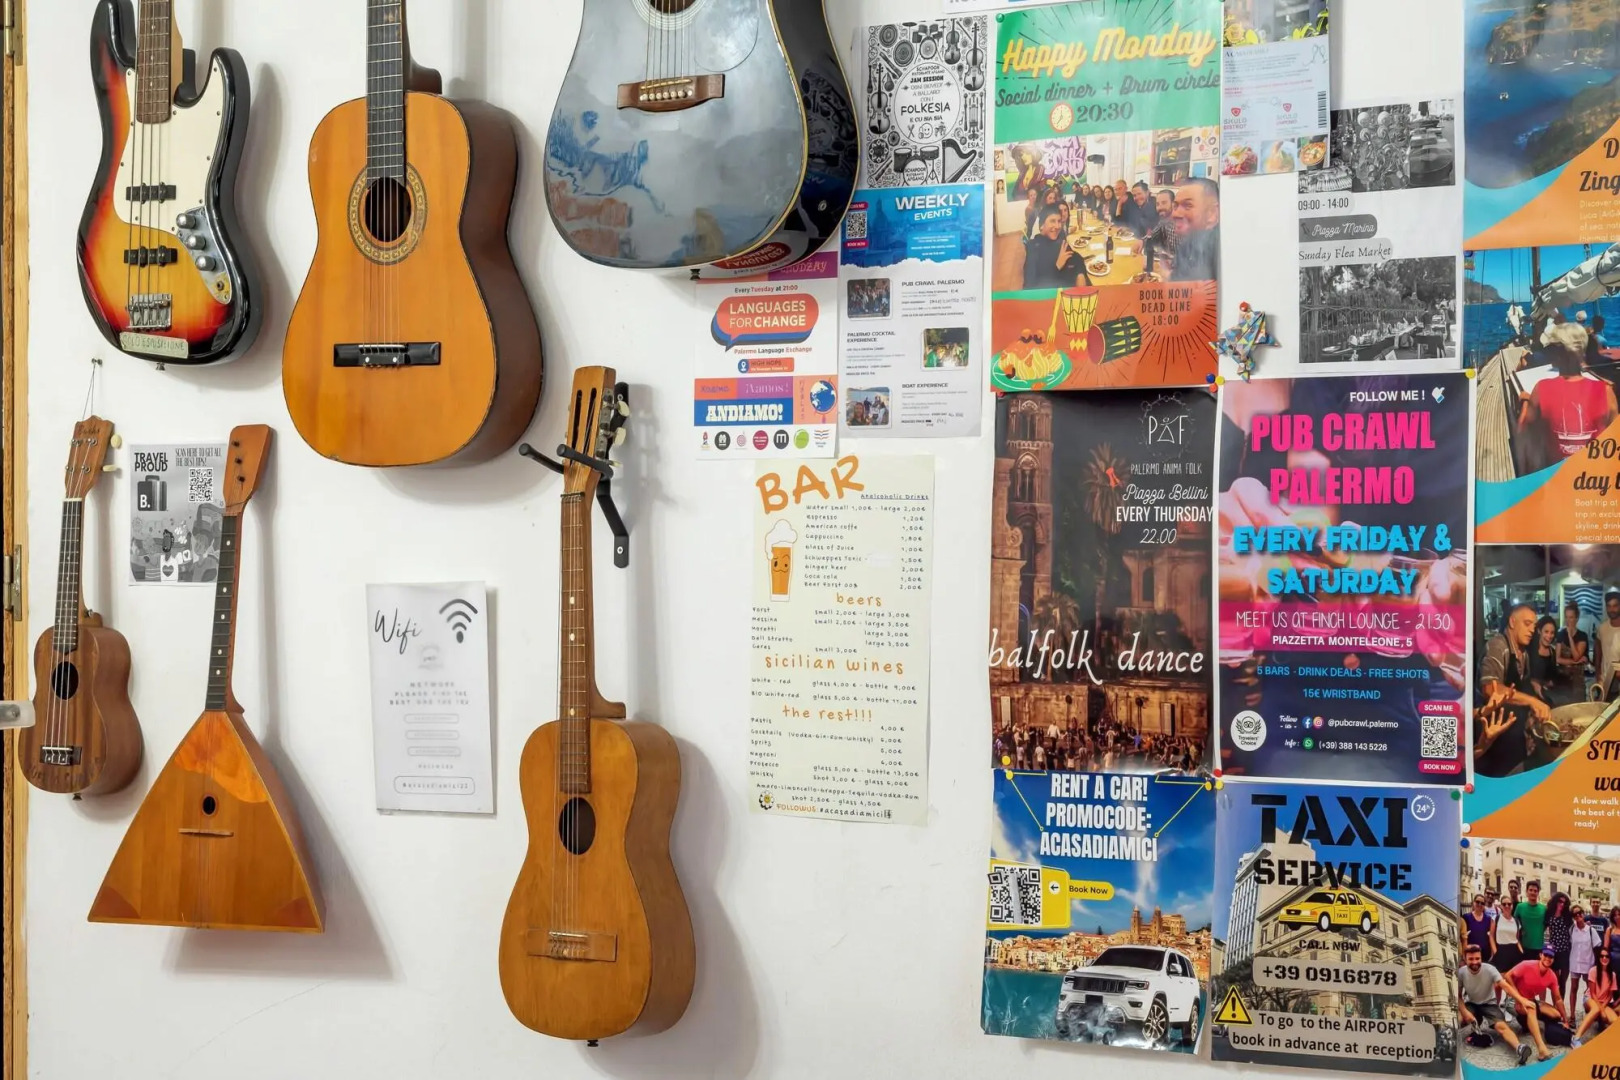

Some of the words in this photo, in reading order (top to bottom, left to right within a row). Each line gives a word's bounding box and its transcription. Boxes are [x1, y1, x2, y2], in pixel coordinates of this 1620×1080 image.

[1002, 38, 1087, 79] Happy
[1092, 23, 1219, 67] Monday
[995, 86, 1042, 108] Social
[1044, 83, 1096, 102] dinner
[1119, 73, 1168, 96] Drum
[1173, 68, 1221, 91] circle
[901, 102, 950, 116] FOLKESIA
[1077, 101, 1133, 123] 20:30
[896, 193, 970, 210] WEEKLY
[1298, 200, 1320, 210] 09:00
[1328, 198, 1349, 208] 14:00
[914, 209, 952, 221] EVENTS
[1312, 224, 1340, 238] Piazza
[1342, 223, 1375, 236] Marina
[1299, 247, 1331, 262] Sunday
[1335, 246, 1354, 258] Flea
[1358, 243, 1391, 260] Market
[1139, 289, 1164, 301] BOOK
[1168, 288, 1193, 299] NOW!
[729, 300, 806, 314] LANGUAGES
[1142, 302, 1165, 313] DEAD
[1170, 301, 1191, 312] LINE
[729, 316, 752, 328] FOR
[754, 315, 806, 327] CHANGE
[1153, 314, 1179, 326] 18:00
[1350, 391, 1398, 402] FOLLOW
[1401, 390, 1419, 401] ME
[706, 404, 783, 422] ANDIAMO!
[1252, 415, 1314, 452] PUB
[1322, 412, 1435, 451] CRAWL
[135, 452, 168, 463] TRAVEL
[175, 448, 186, 457] SCAN
[135, 462, 168, 472] PROUD
[184, 457, 194, 466] BEST
[1130, 463, 1159, 475] PALERMO
[1163, 463, 1182, 474] ANIMA
[1185, 462, 1202, 474] FOLK
[756, 455, 864, 515] BAR
[1270, 466, 1414, 505] PALERMO
[1574, 471, 1612, 496] day
[1122, 484, 1165, 504] Piazza
[1168, 484, 1208, 500] Bellini
[1116, 506, 1151, 522] EVERY
[1154, 506, 1214, 522] THURSDAY
[1140, 529, 1177, 544] 22:00
[1234, 526, 1318, 552] EVERY
[1327, 525, 1426, 552] FRIDAY
[1434, 524, 1452, 551] &
[1267, 568, 1418, 594] SATURDAY
[836, 592, 882, 607] beers
[1236, 612, 1267, 628] MEET
[1272, 611, 1288, 628] US
[1312, 612, 1344, 629] FINCH
[1349, 613, 1400, 630] LOUNGE
[375, 607, 422, 655] Wifi
[1272, 636, 1324, 646] PIAZZETTA
[1406, 637, 1413, 647] 5
[765, 654, 835, 669] sicilian
[846, 658, 904, 675] wines
[988, 628, 1103, 685] balfolk
[1118, 631, 1204, 673] dance
[1257, 667, 1262, 675] 5
[1265, 667, 1290, 676] BARS
[1298, 668, 1328, 677] DRINK
[1331, 668, 1362, 678] DEALS
[1369, 669, 1394, 678] FREE
[1395, 669, 1429, 679] SHOTS
[1303, 689, 1320, 699] 15€
[1322, 689, 1381, 700] WRISTBAND
[782, 705, 810, 718] the
[819, 708, 872, 722] rest!!!
[1328, 719, 1398, 729] @pubcrawl.palermo
[1318, 742, 1337, 750] (+39)
[1339, 742, 1352, 750] 388
[1369, 743, 1387, 751] 5226
[1051, 773, 1089, 800] RENT
[1094, 774, 1105, 800] A
[1110, 776, 1148, 802] CAR!
[1046, 802, 1152, 832] PROMOCODE:
[1251, 794, 1408, 848] TAXI
[1574, 820, 1599, 830] ready!
[1040, 832, 1158, 862] ACASADIAMICI
[1253, 858, 1412, 891] SERVICE
[1069, 885, 1088, 894] Book
[1090, 886, 1108, 895] Now
[1299, 940, 1329, 951] CALL
[1332, 941, 1360, 952] NOW
[1262, 966, 1299, 980] +39
[1305, 966, 1397, 986] 0916878
[1259, 1013, 1275, 1026] To
[1278, 1017, 1294, 1030] go
[1300, 1017, 1315, 1028] to
[1318, 1017, 1341, 1031] the
[1344, 1020, 1405, 1035] AIRPORT
[1232, 1033, 1265, 1047] book
[1268, 1035, 1281, 1048] in
[1285, 1036, 1340, 1052] advance
[1344, 1040, 1358, 1054] at
[1366, 1042, 1437, 1061] reception!
